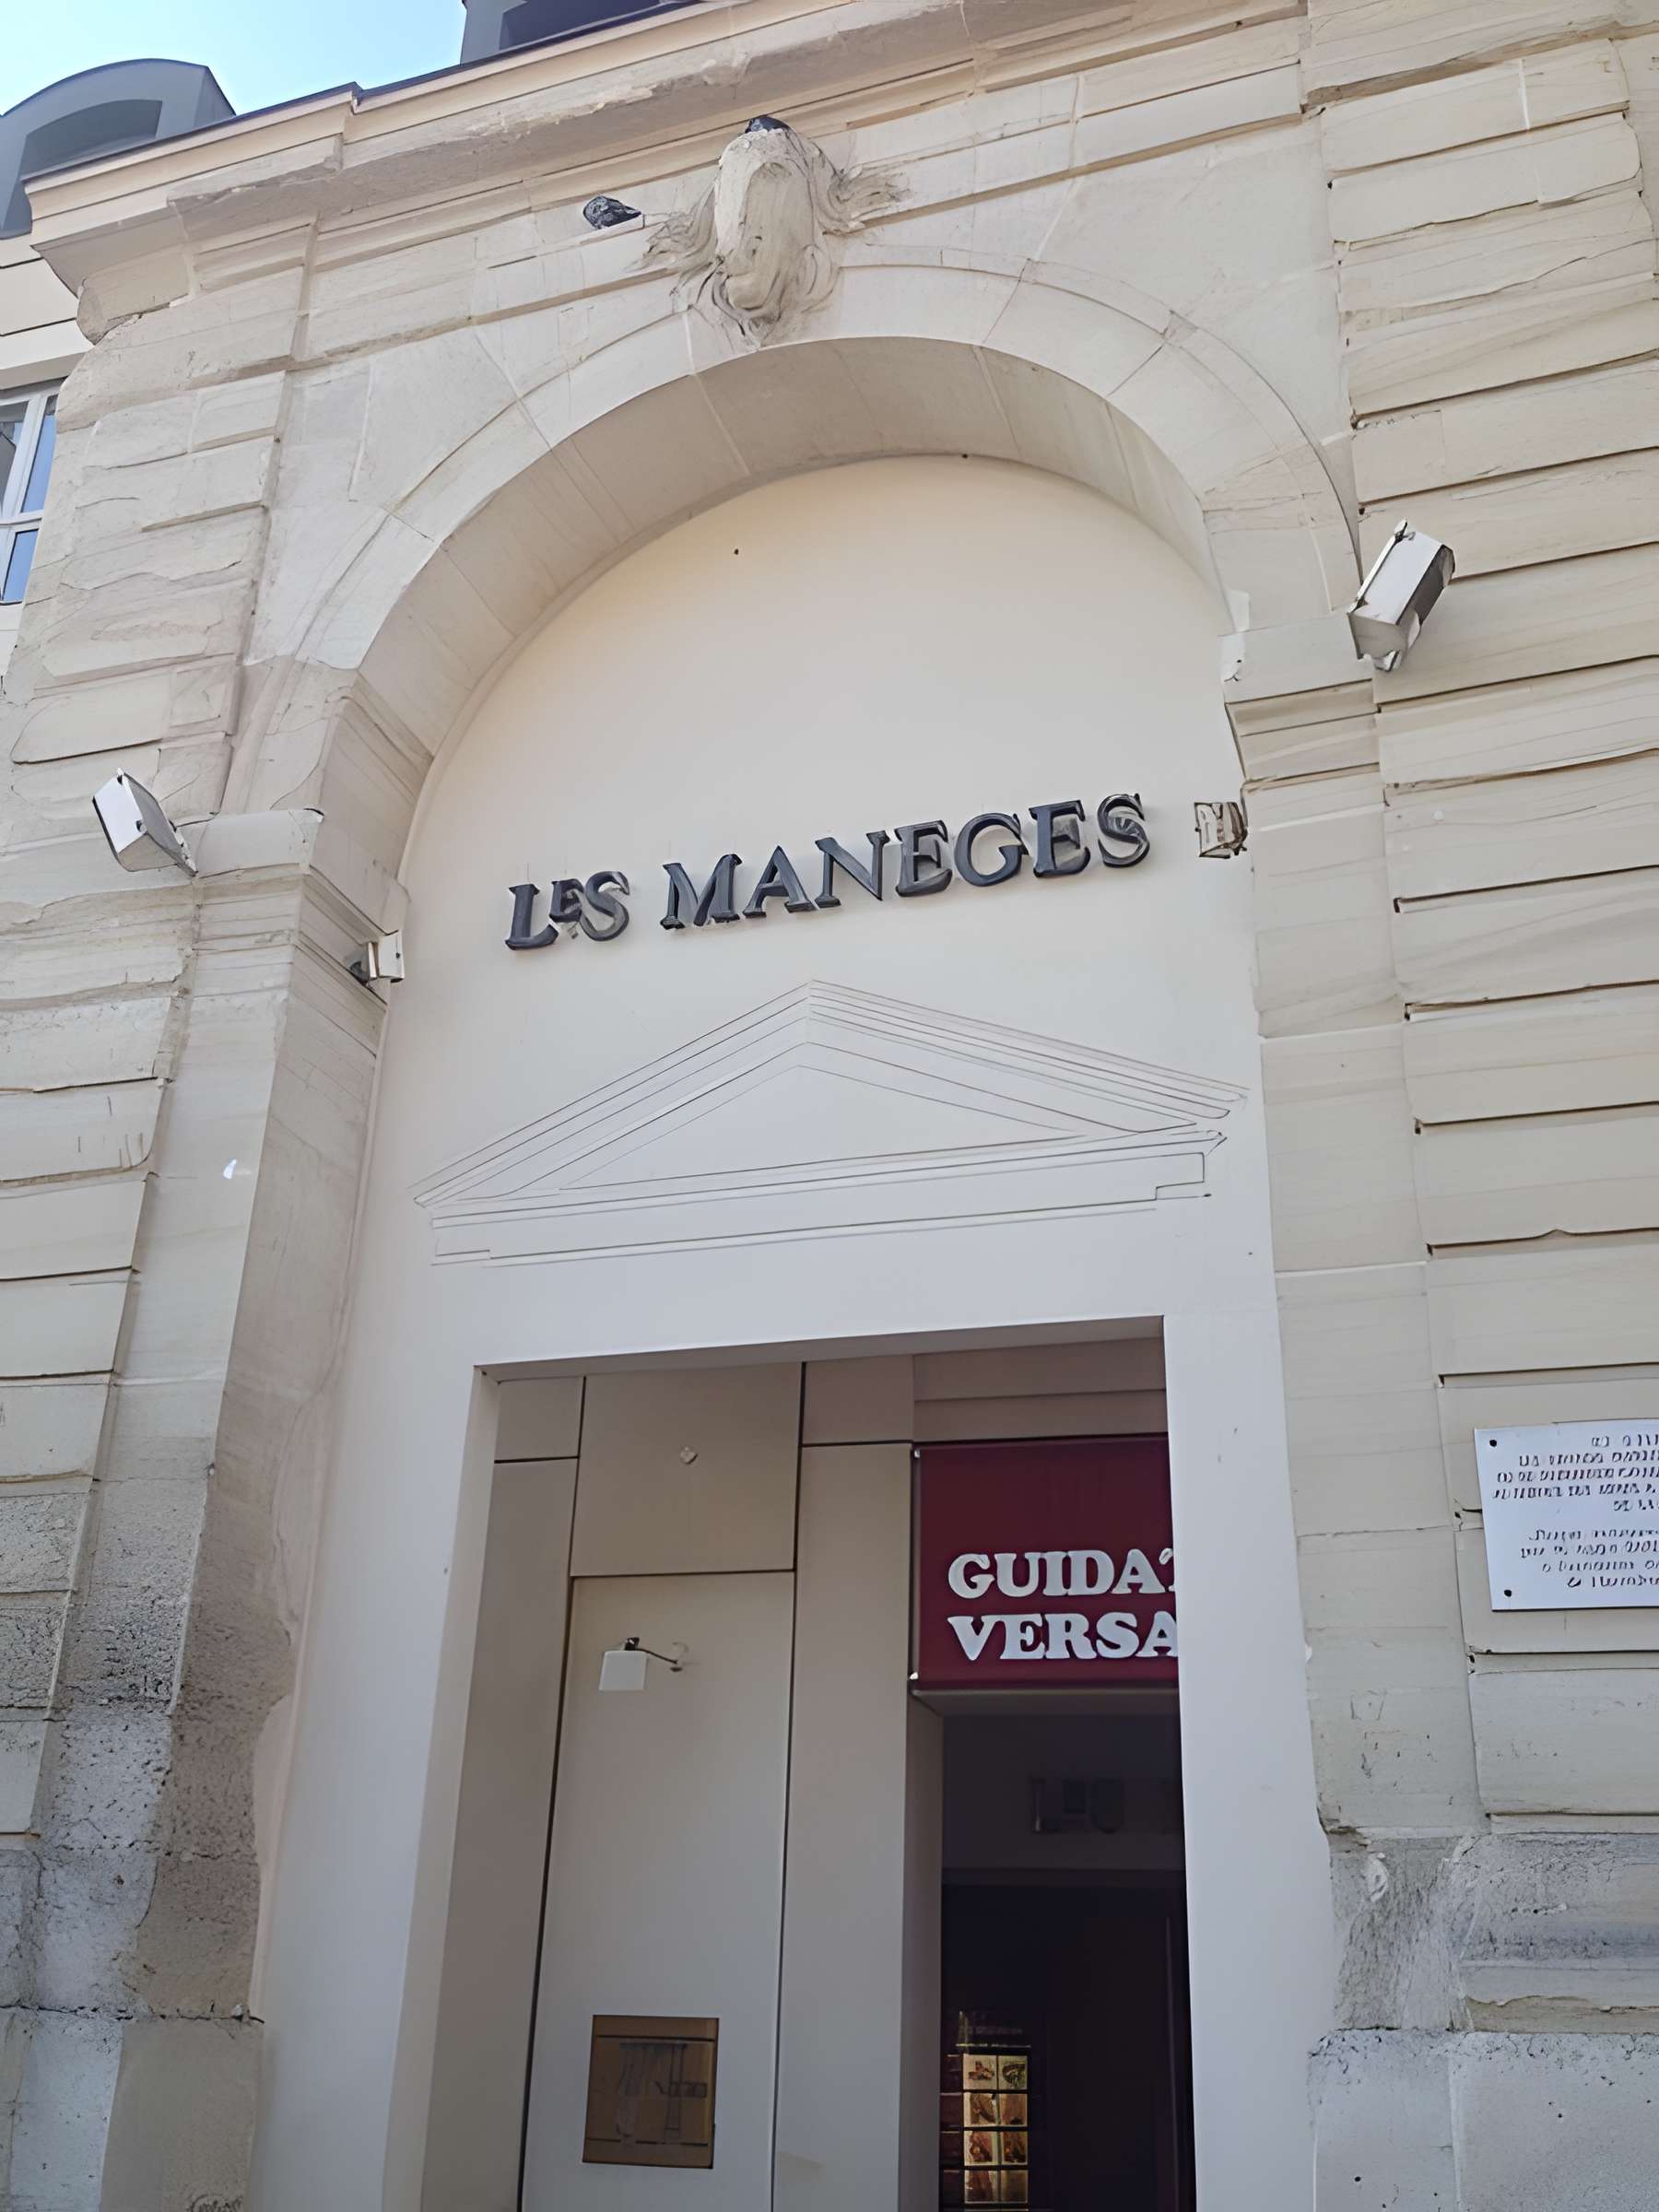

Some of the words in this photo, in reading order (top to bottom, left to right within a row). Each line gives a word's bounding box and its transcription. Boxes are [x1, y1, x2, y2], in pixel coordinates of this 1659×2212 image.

[505, 871, 630, 950] LES
[660, 794, 1149, 930] MANEGES
[947, 1611, 1179, 1661] VERSA
